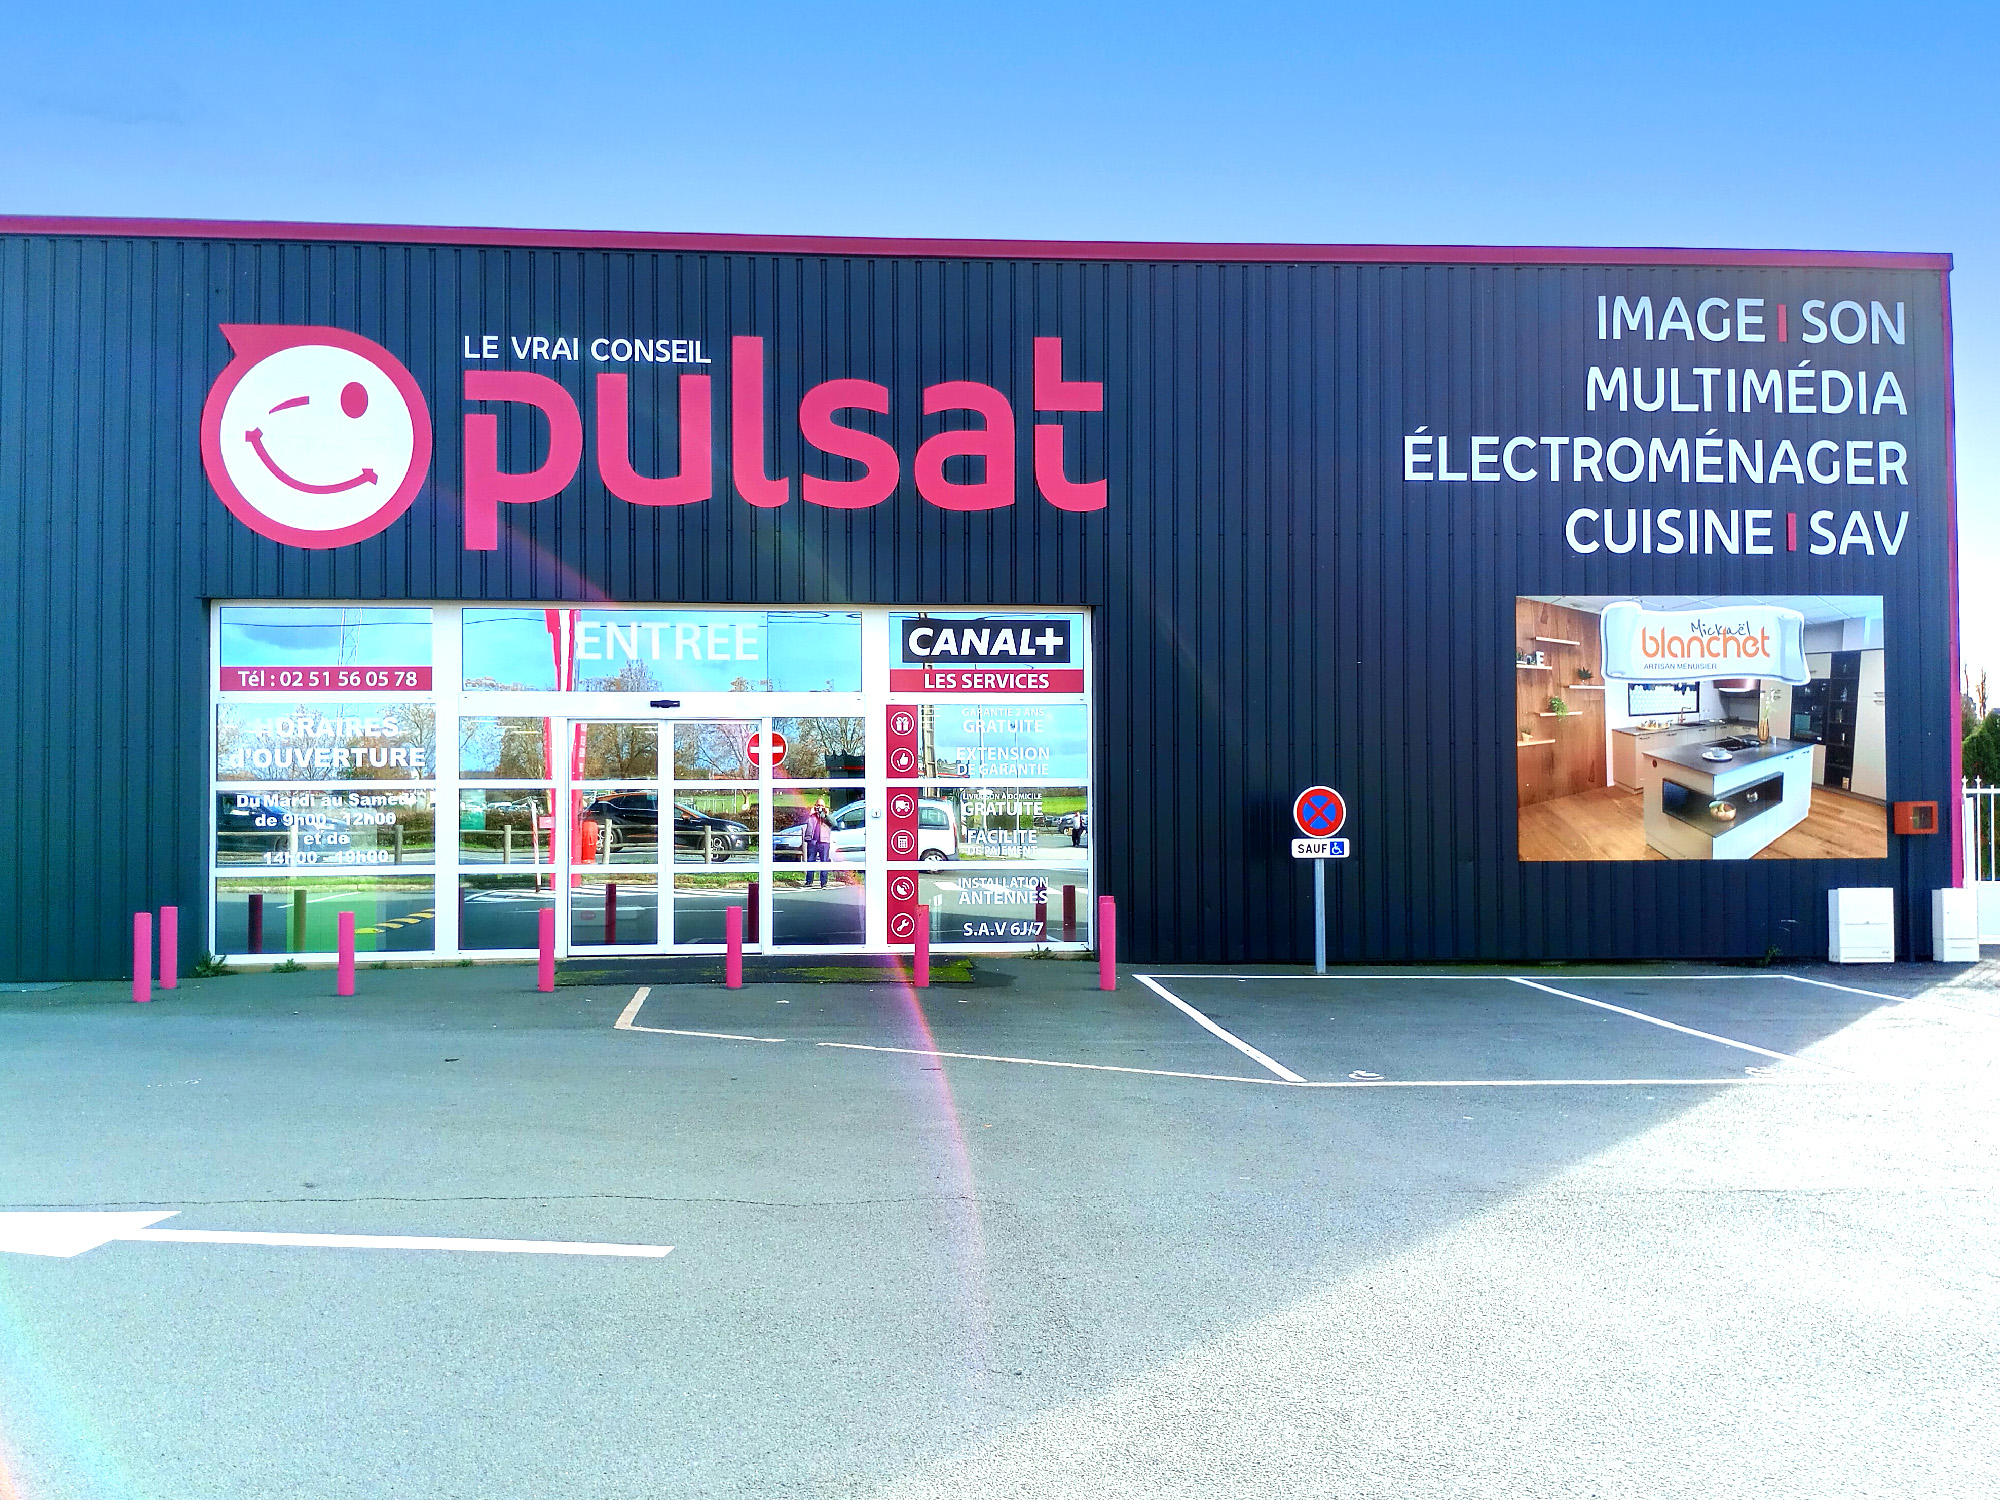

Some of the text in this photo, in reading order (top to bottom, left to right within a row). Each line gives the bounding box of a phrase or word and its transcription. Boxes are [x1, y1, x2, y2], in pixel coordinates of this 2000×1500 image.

[1598, 296, 1906, 345] IMAGE SON
[464, 335, 712, 364] LE VRAI CONSEIL
[1586, 360, 1908, 415] MULTIMÉDIA
[464, 335, 1109, 551] pulsat
[1403, 426, 1909, 485] ÉLECTROMÉNAGER
[1565, 508, 1909, 555] CUISINE SAV
[1690, 619, 1751, 637] Mickaël
[576, 620, 760, 661] ENTREE
[908, 627, 1064, 657] CANAL+
[1641, 626, 1770, 658] blanchet
[238, 671, 265, 687] Tél
[279, 671, 303, 687] 02
[308, 671, 330, 687] 51
[338, 671, 361, 687] 56
[365, 671, 388, 687] 05
[394, 671, 418, 687] 78
[924, 673, 1050, 689] LES SERVICES
[962, 708, 1045, 717] GARANTIE 2 ANS
[256, 717, 399, 738] HORAIRES
[963, 719, 1044, 734] GRATUITE
[956, 747, 1050, 760] EXTENSION
[958, 763, 1049, 775] DE GARANTIE
[236, 795, 260, 808] Du
[264, 794, 315, 807] Mardi
[321, 796, 343, 807] au
[963, 801, 1044, 816] GRATUITE
[255, 814, 278, 827] de
[343, 812, 397, 826] 12h00
[303, 831, 350, 845] et de
[966, 846, 1038, 855] DE PAIEMENT
[1297, 843, 1328, 854] SAUF
[958, 877, 1049, 888] INSTALLATION
[958, 890, 1048, 905] ANTENNES
[963, 921, 1044, 936] S.A.V 6J/7
